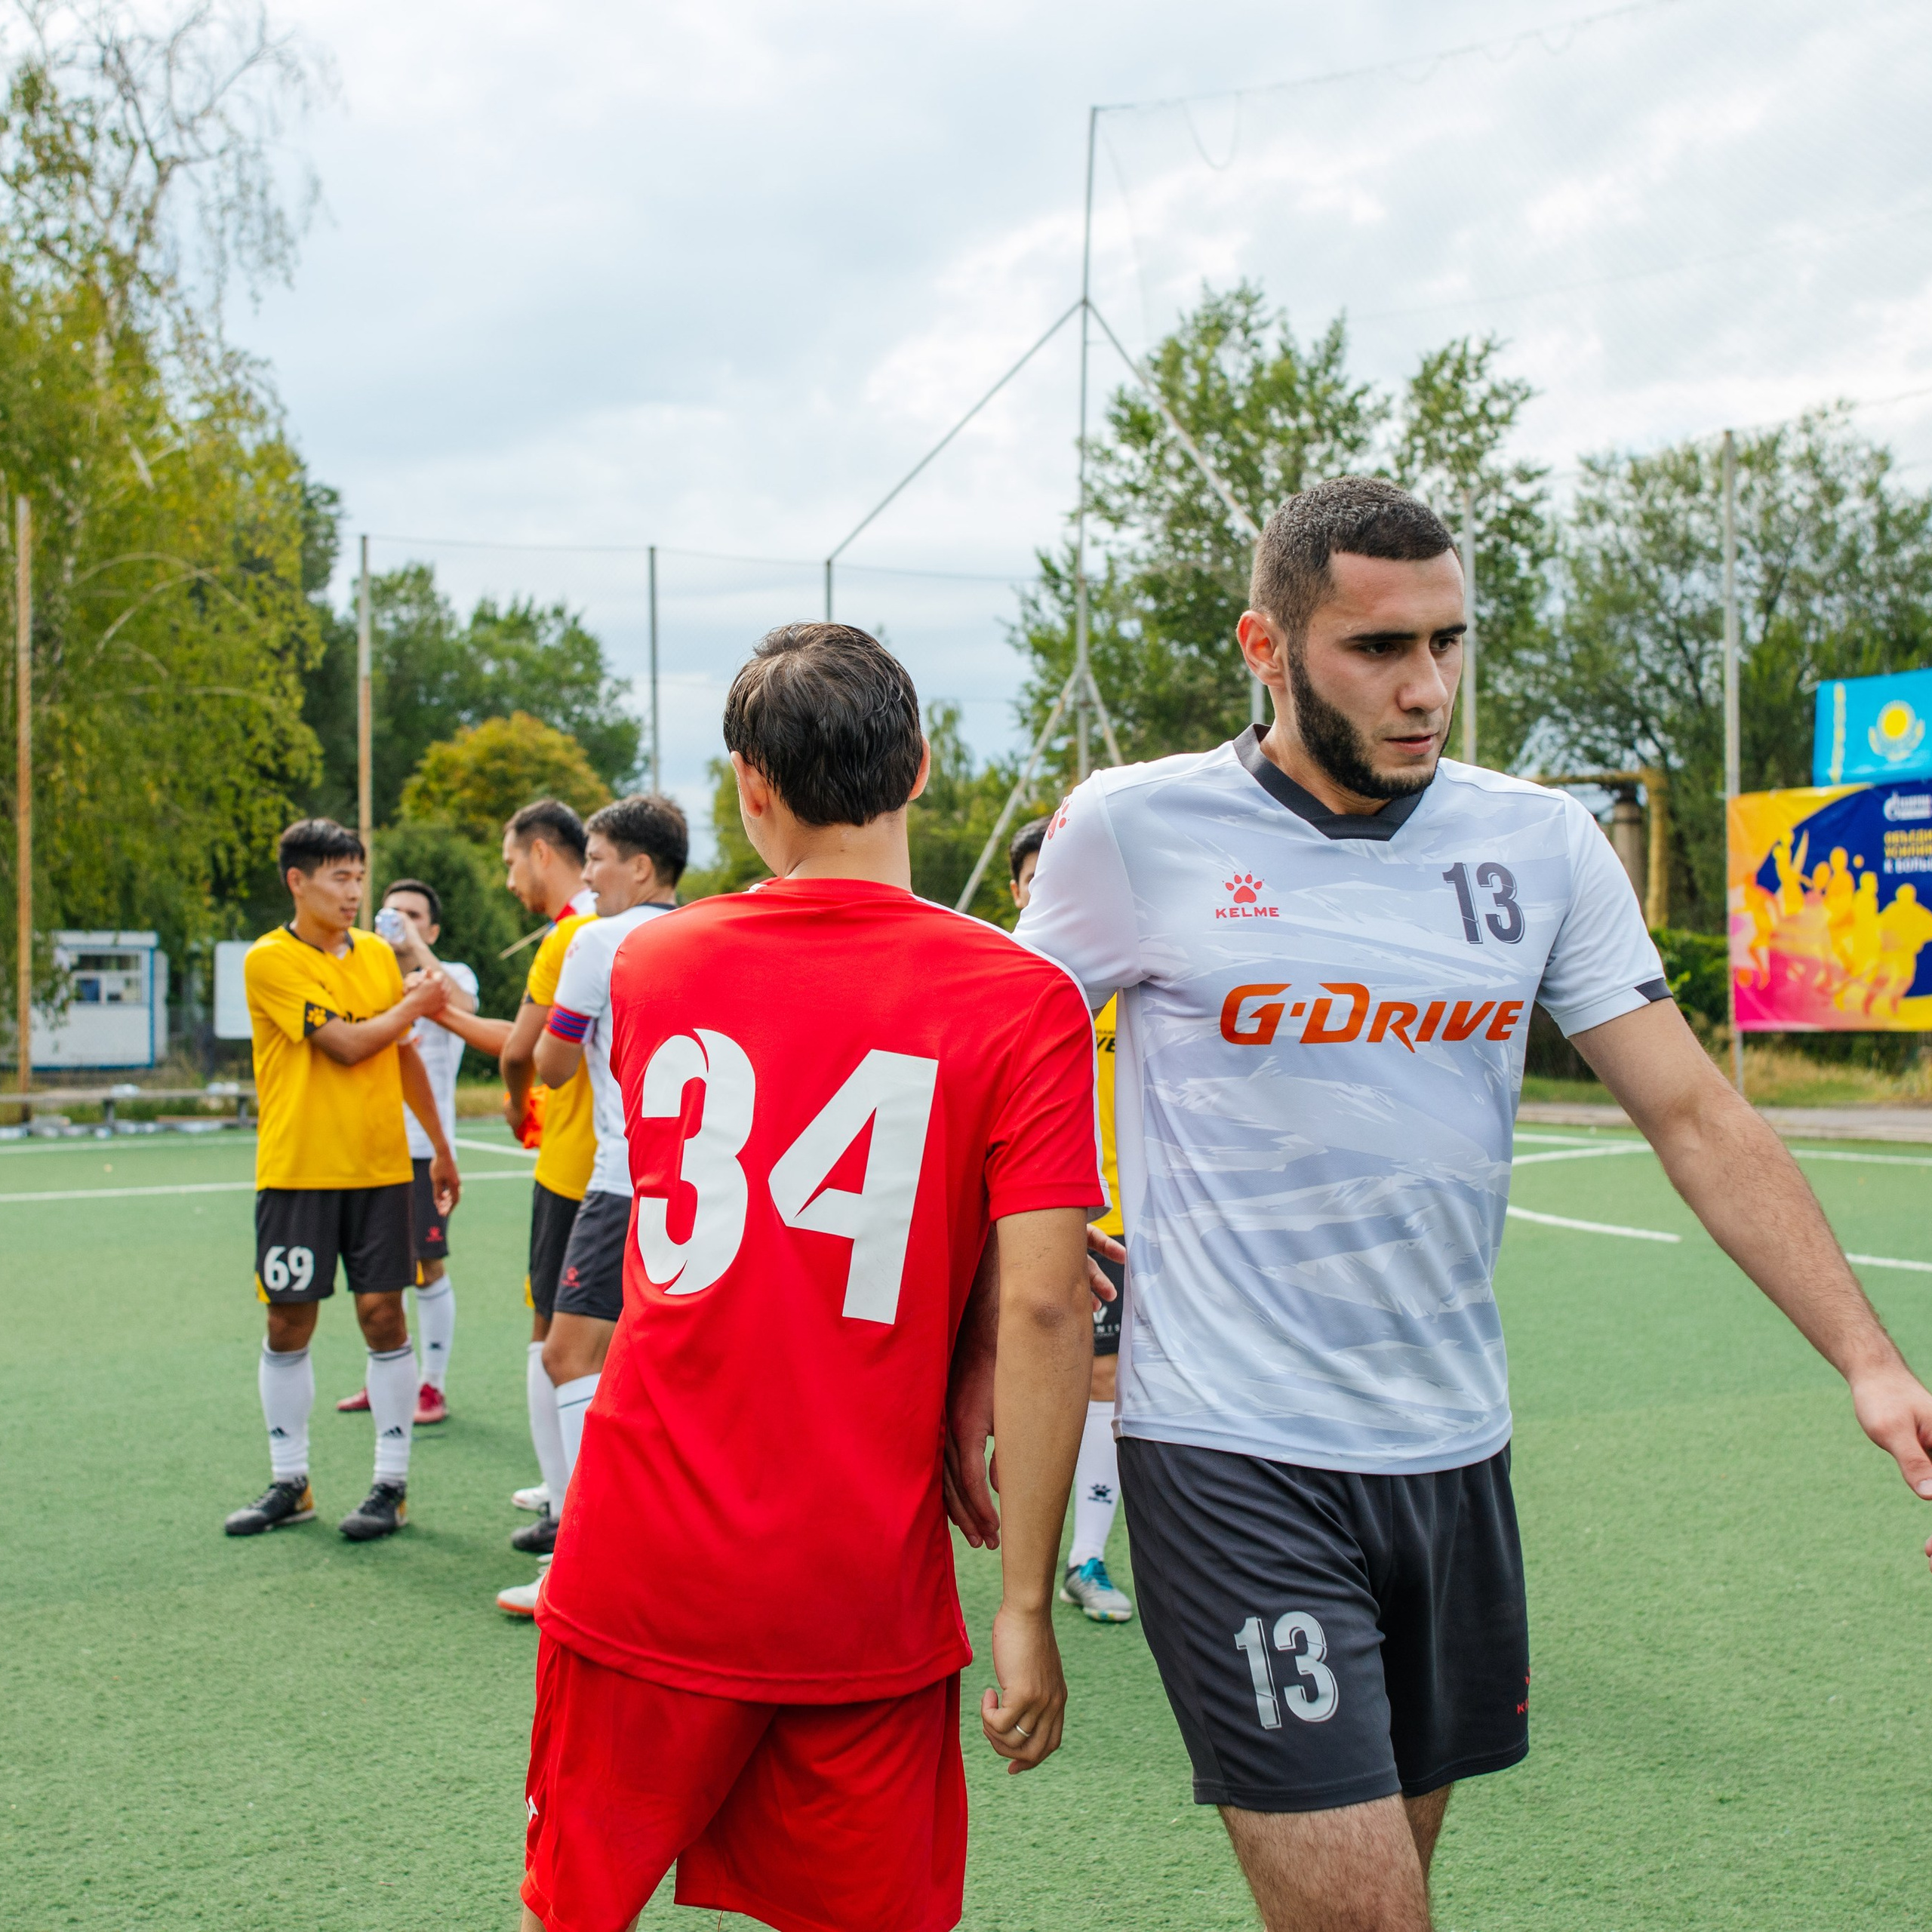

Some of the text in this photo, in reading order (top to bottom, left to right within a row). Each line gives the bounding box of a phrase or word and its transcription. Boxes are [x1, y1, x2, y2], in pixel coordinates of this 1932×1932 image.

[1216, 906, 1280, 918] KELME
[1442, 862, 1525, 944] 13
[637, 1028, 939, 1324] 34
[263, 1245, 315, 1291] 69
[1234, 1611, 1339, 1730] 13
